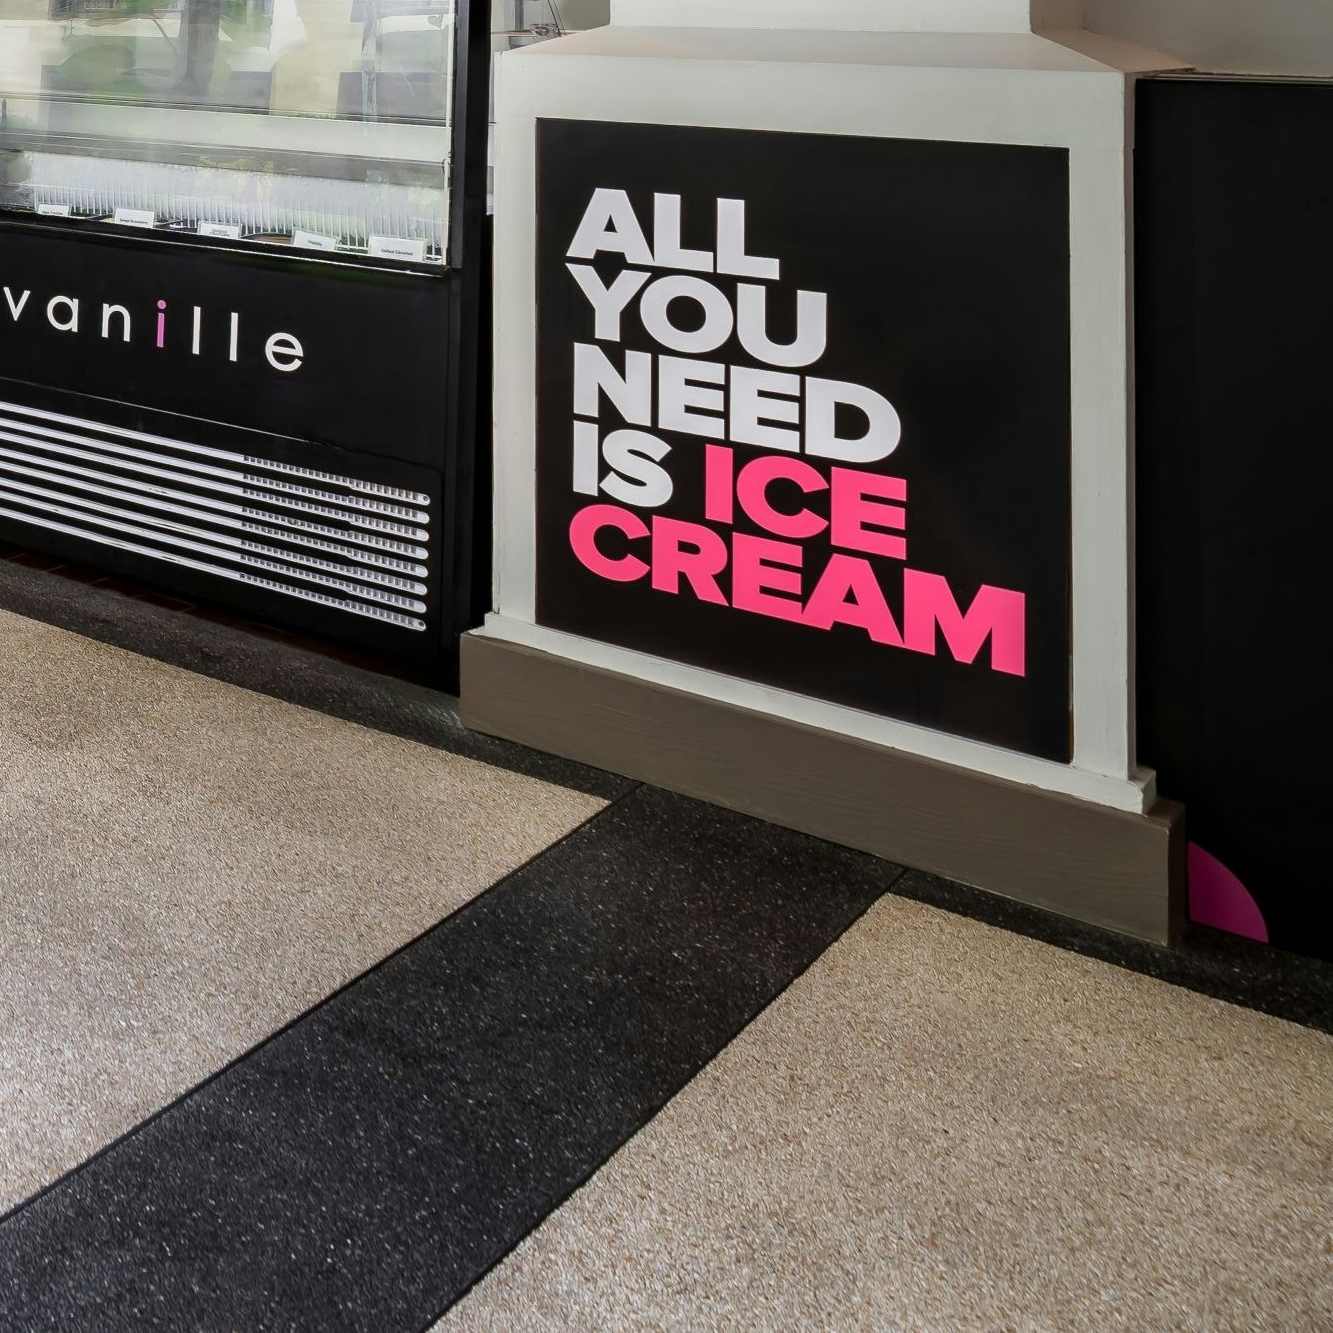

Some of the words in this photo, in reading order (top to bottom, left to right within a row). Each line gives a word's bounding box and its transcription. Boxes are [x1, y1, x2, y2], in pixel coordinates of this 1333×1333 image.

[565, 187, 780, 280] ALL
[564, 262, 827, 367] YOU
[573, 341, 902, 463] NEED
[573, 419, 673, 508] IS
[705, 443, 907, 561] ICE
[569, 504, 1025, 677] CREAM
